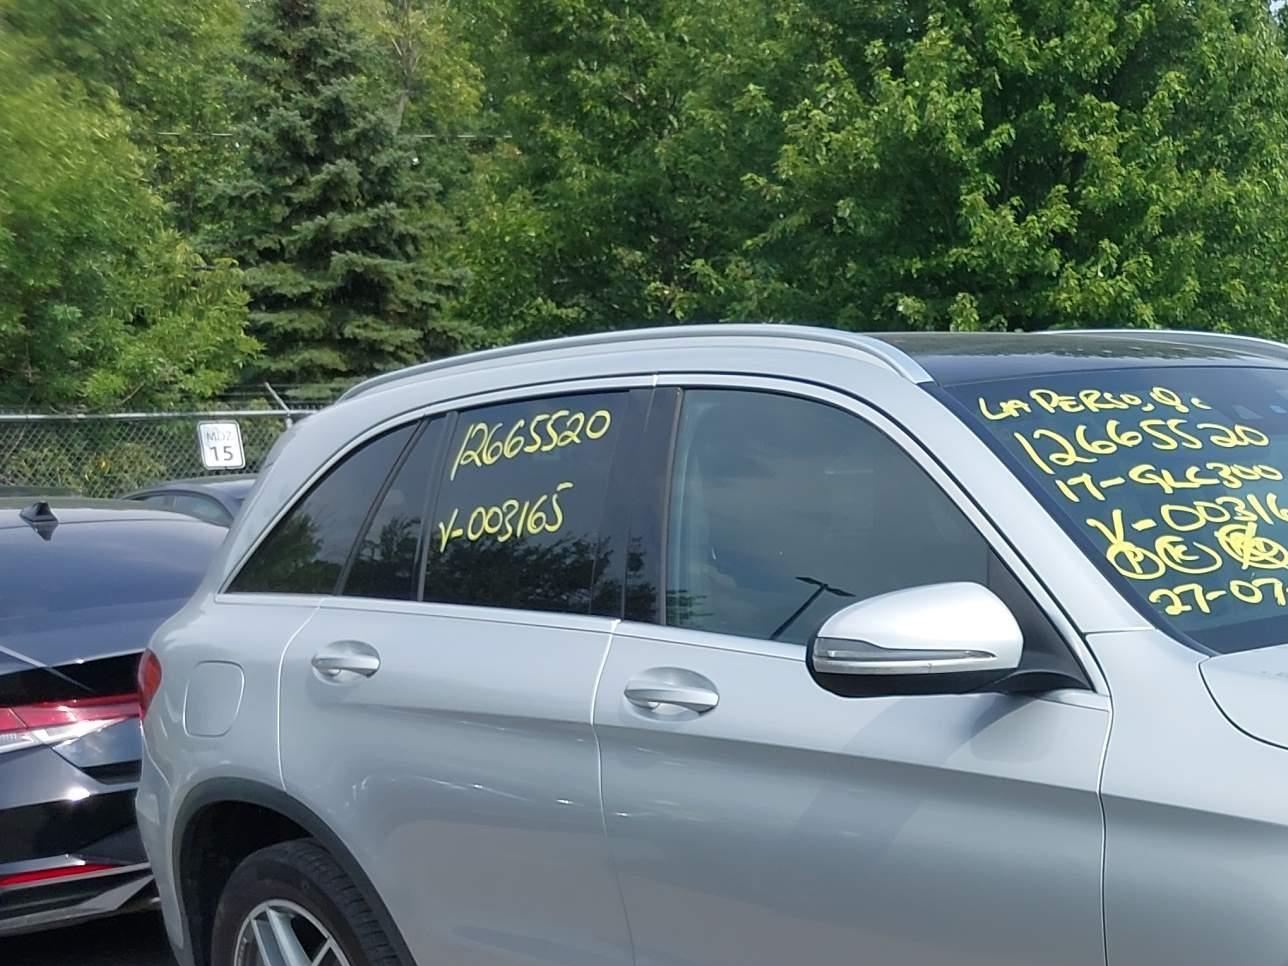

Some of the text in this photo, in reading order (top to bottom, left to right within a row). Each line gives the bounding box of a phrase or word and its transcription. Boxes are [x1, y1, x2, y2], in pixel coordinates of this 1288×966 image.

[979, 399, 1031, 420] LA
[209, 445, 234, 462] 15
[451, 410, 611, 480] 12665520
[1014, 419, 1269, 474] 12665520
